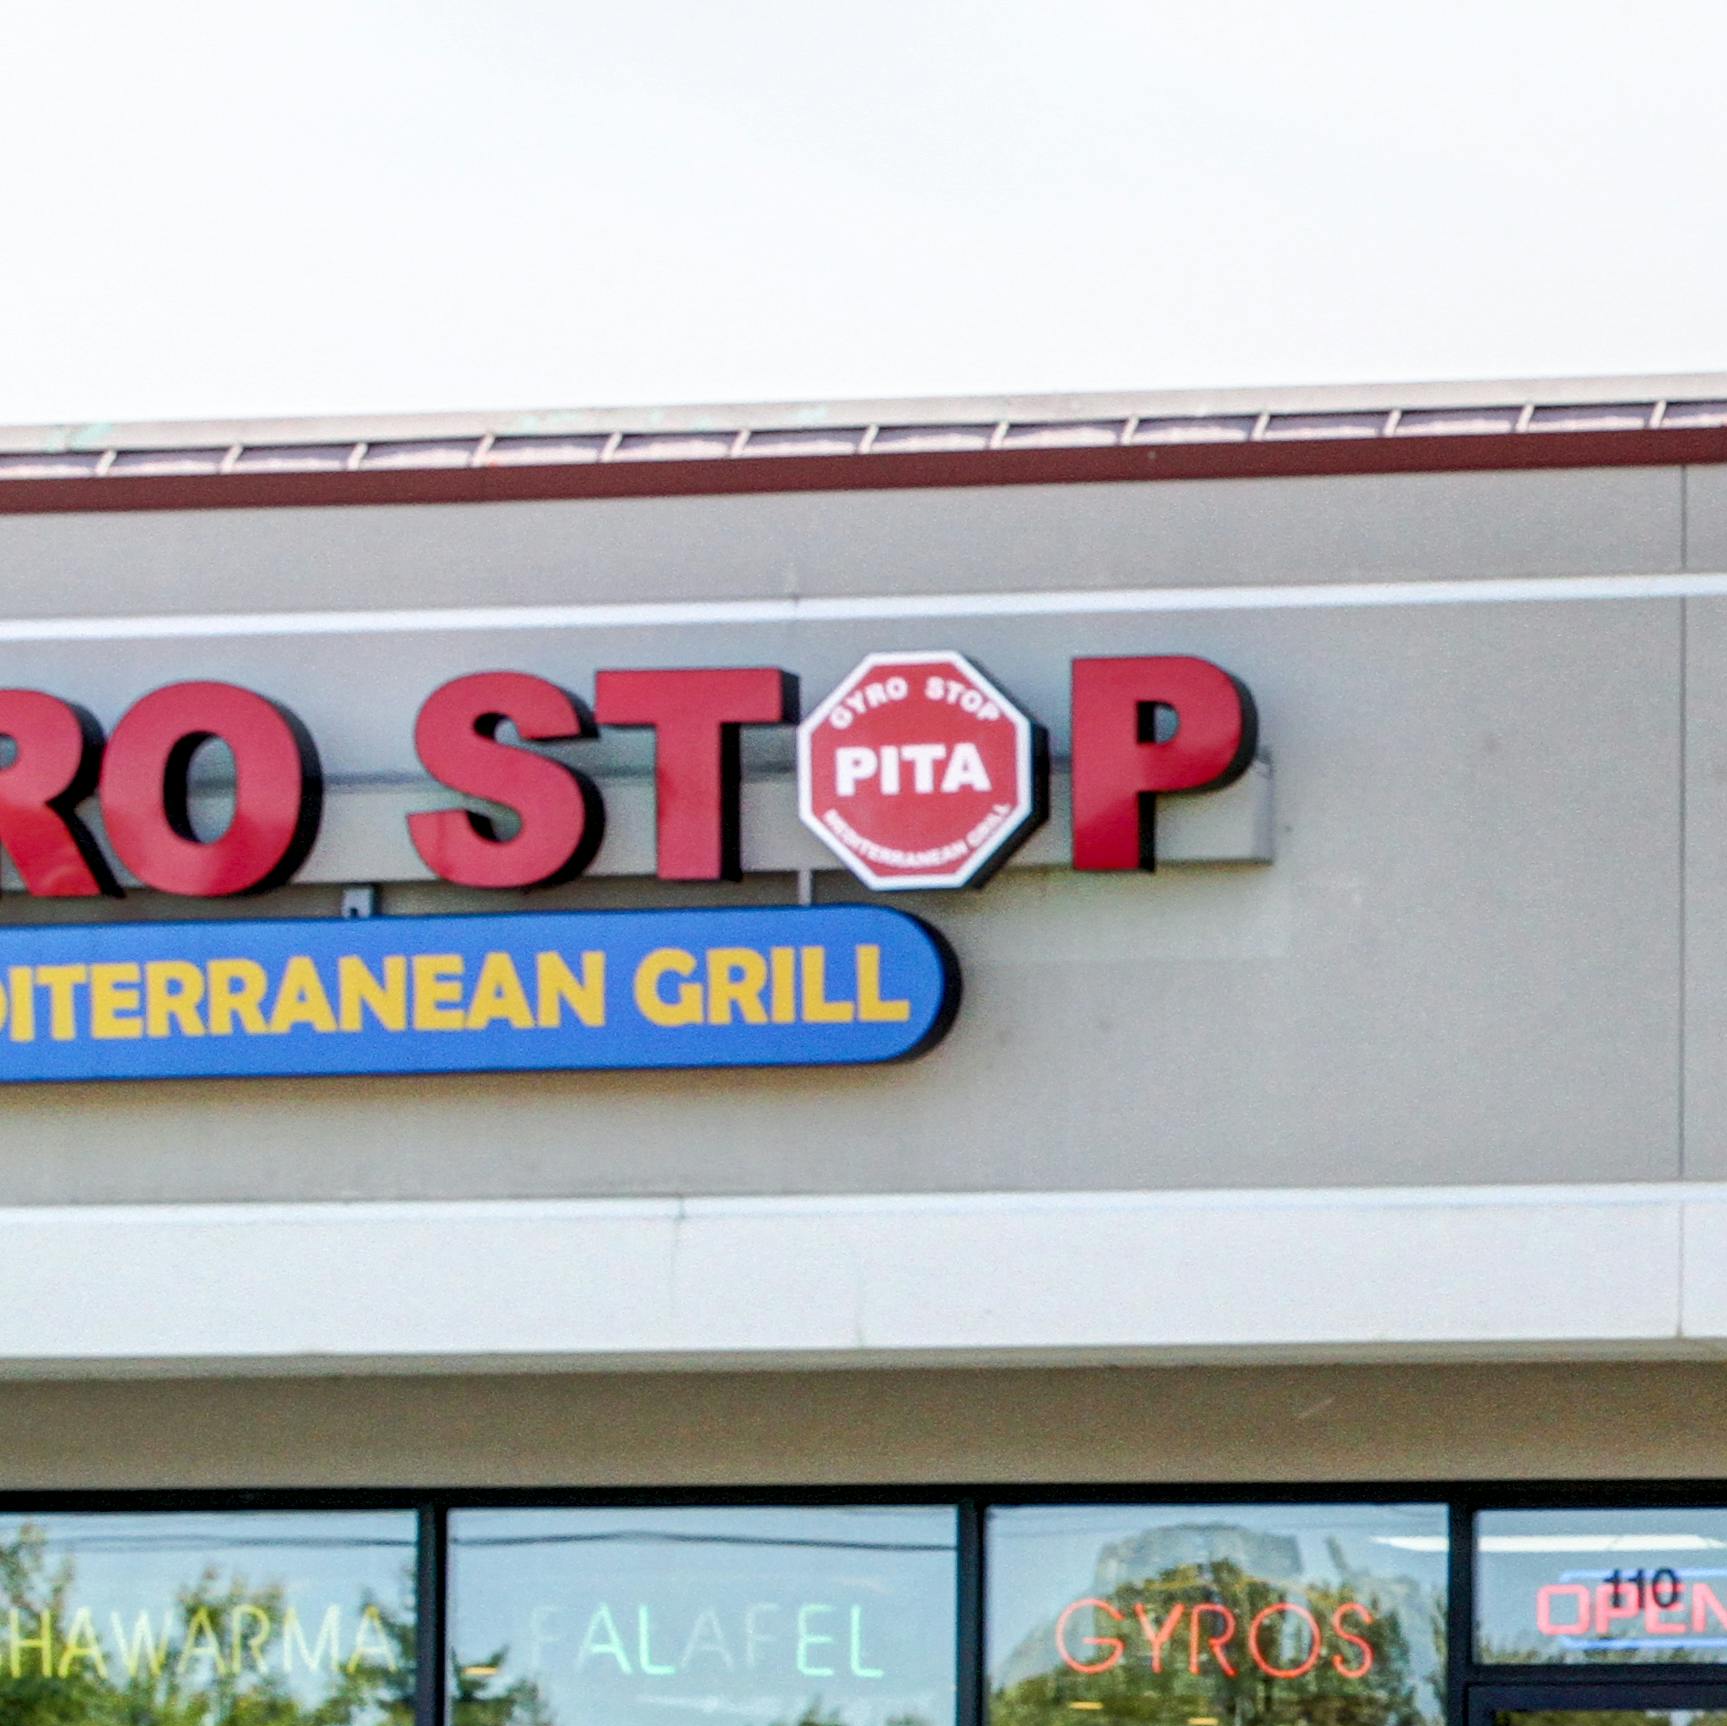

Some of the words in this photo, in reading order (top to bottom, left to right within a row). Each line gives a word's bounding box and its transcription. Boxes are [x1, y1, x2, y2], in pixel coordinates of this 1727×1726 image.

[829, 677, 908, 729] GYRO
[924, 676, 1001, 721] STOP
[835, 742, 992, 797] PITA
[0, 950, 605, 1042] ITERRANEAN
[634, 944, 909, 1029] GRILL
[1603, 1566, 1681, 1609] 110
[0, 1604, 398, 1679] HAWARMA
[528, 1601, 885, 1679] FALAFEL
[1055, 1598, 1374, 1679] GYROS
